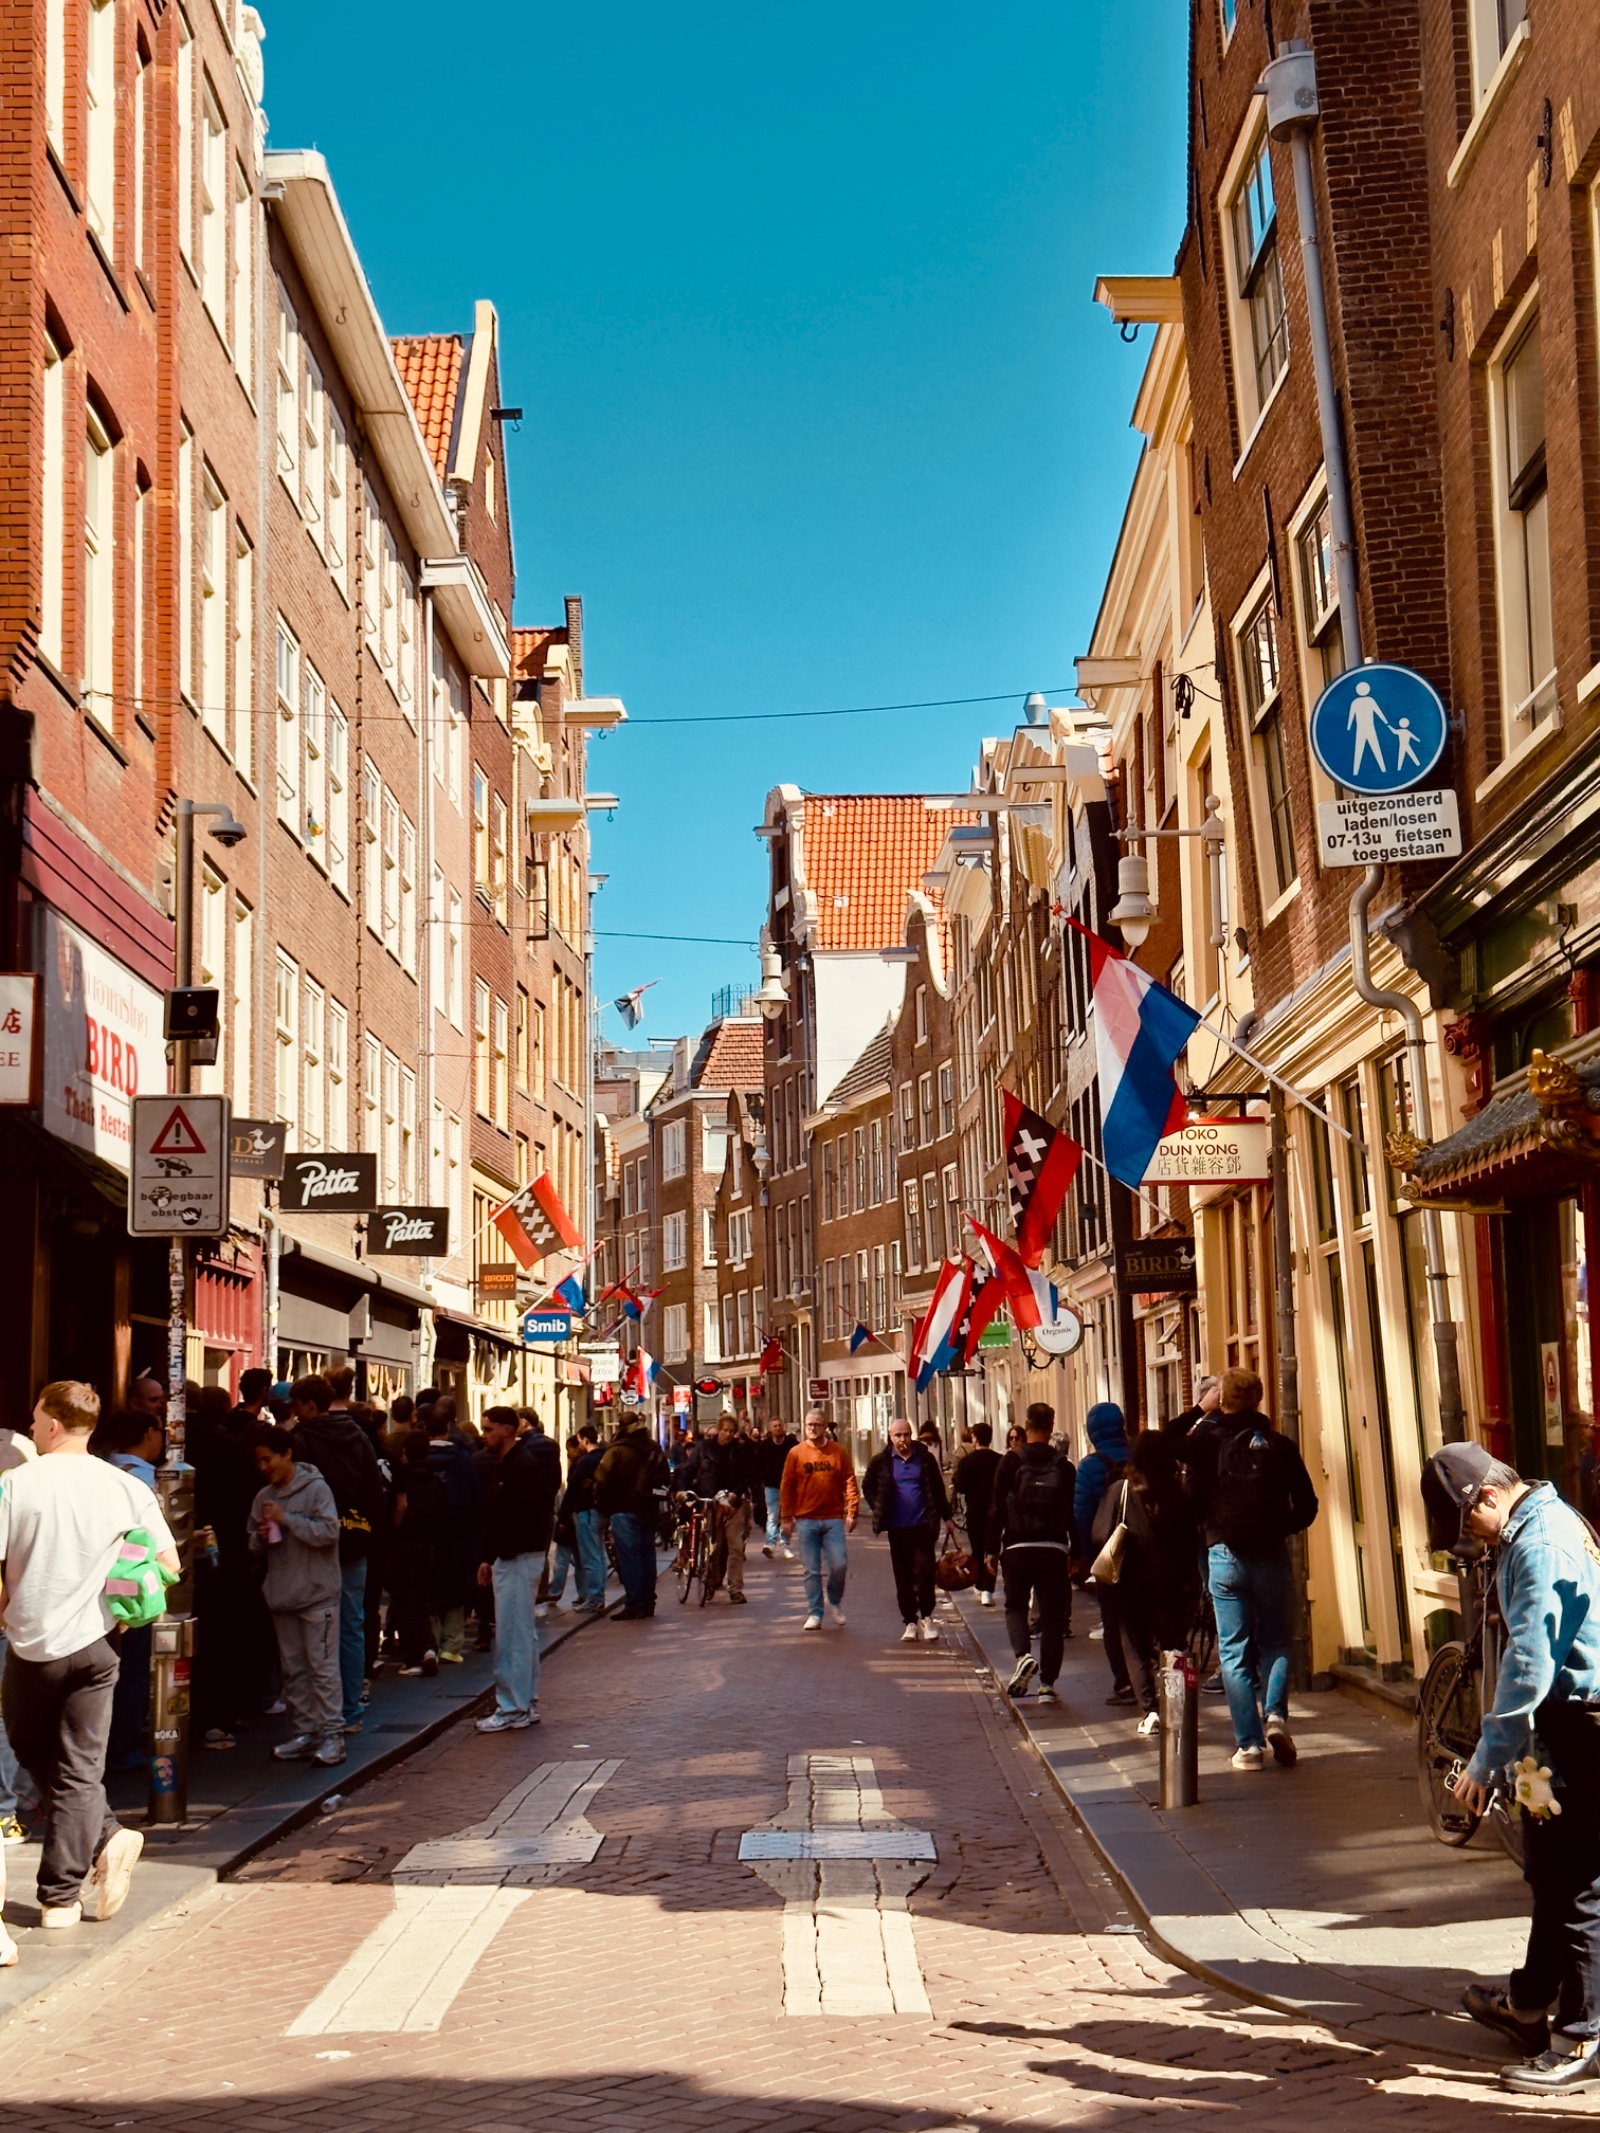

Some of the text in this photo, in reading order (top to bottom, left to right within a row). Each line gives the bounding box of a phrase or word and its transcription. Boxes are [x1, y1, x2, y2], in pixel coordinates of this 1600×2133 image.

[1337, 792, 1443, 816] uitgezonderd
[1344, 812, 1437, 832] laden/losen
[1327, 827, 1452, 849] 07-13u fietsen
[1352, 842, 1445, 862] toegestaan
[85, 1014, 139, 1097] BIRD
[1180, 1128, 1218, 1141] TOKO
[1160, 1144, 1239, 1156] DUN YONG
[295, 1160, 361, 1207] Patta
[141, 1192, 214, 1202] beegbaar
[151, 1208, 202, 1218] obstl
[382, 1211, 436, 1249] Patta
[1125, 1256, 1180, 1274] BIRD
[484, 1274, 515, 1283] BROOD
[527, 1319, 567, 1333] Smib
[1041, 1327, 1073, 1337] Organic
